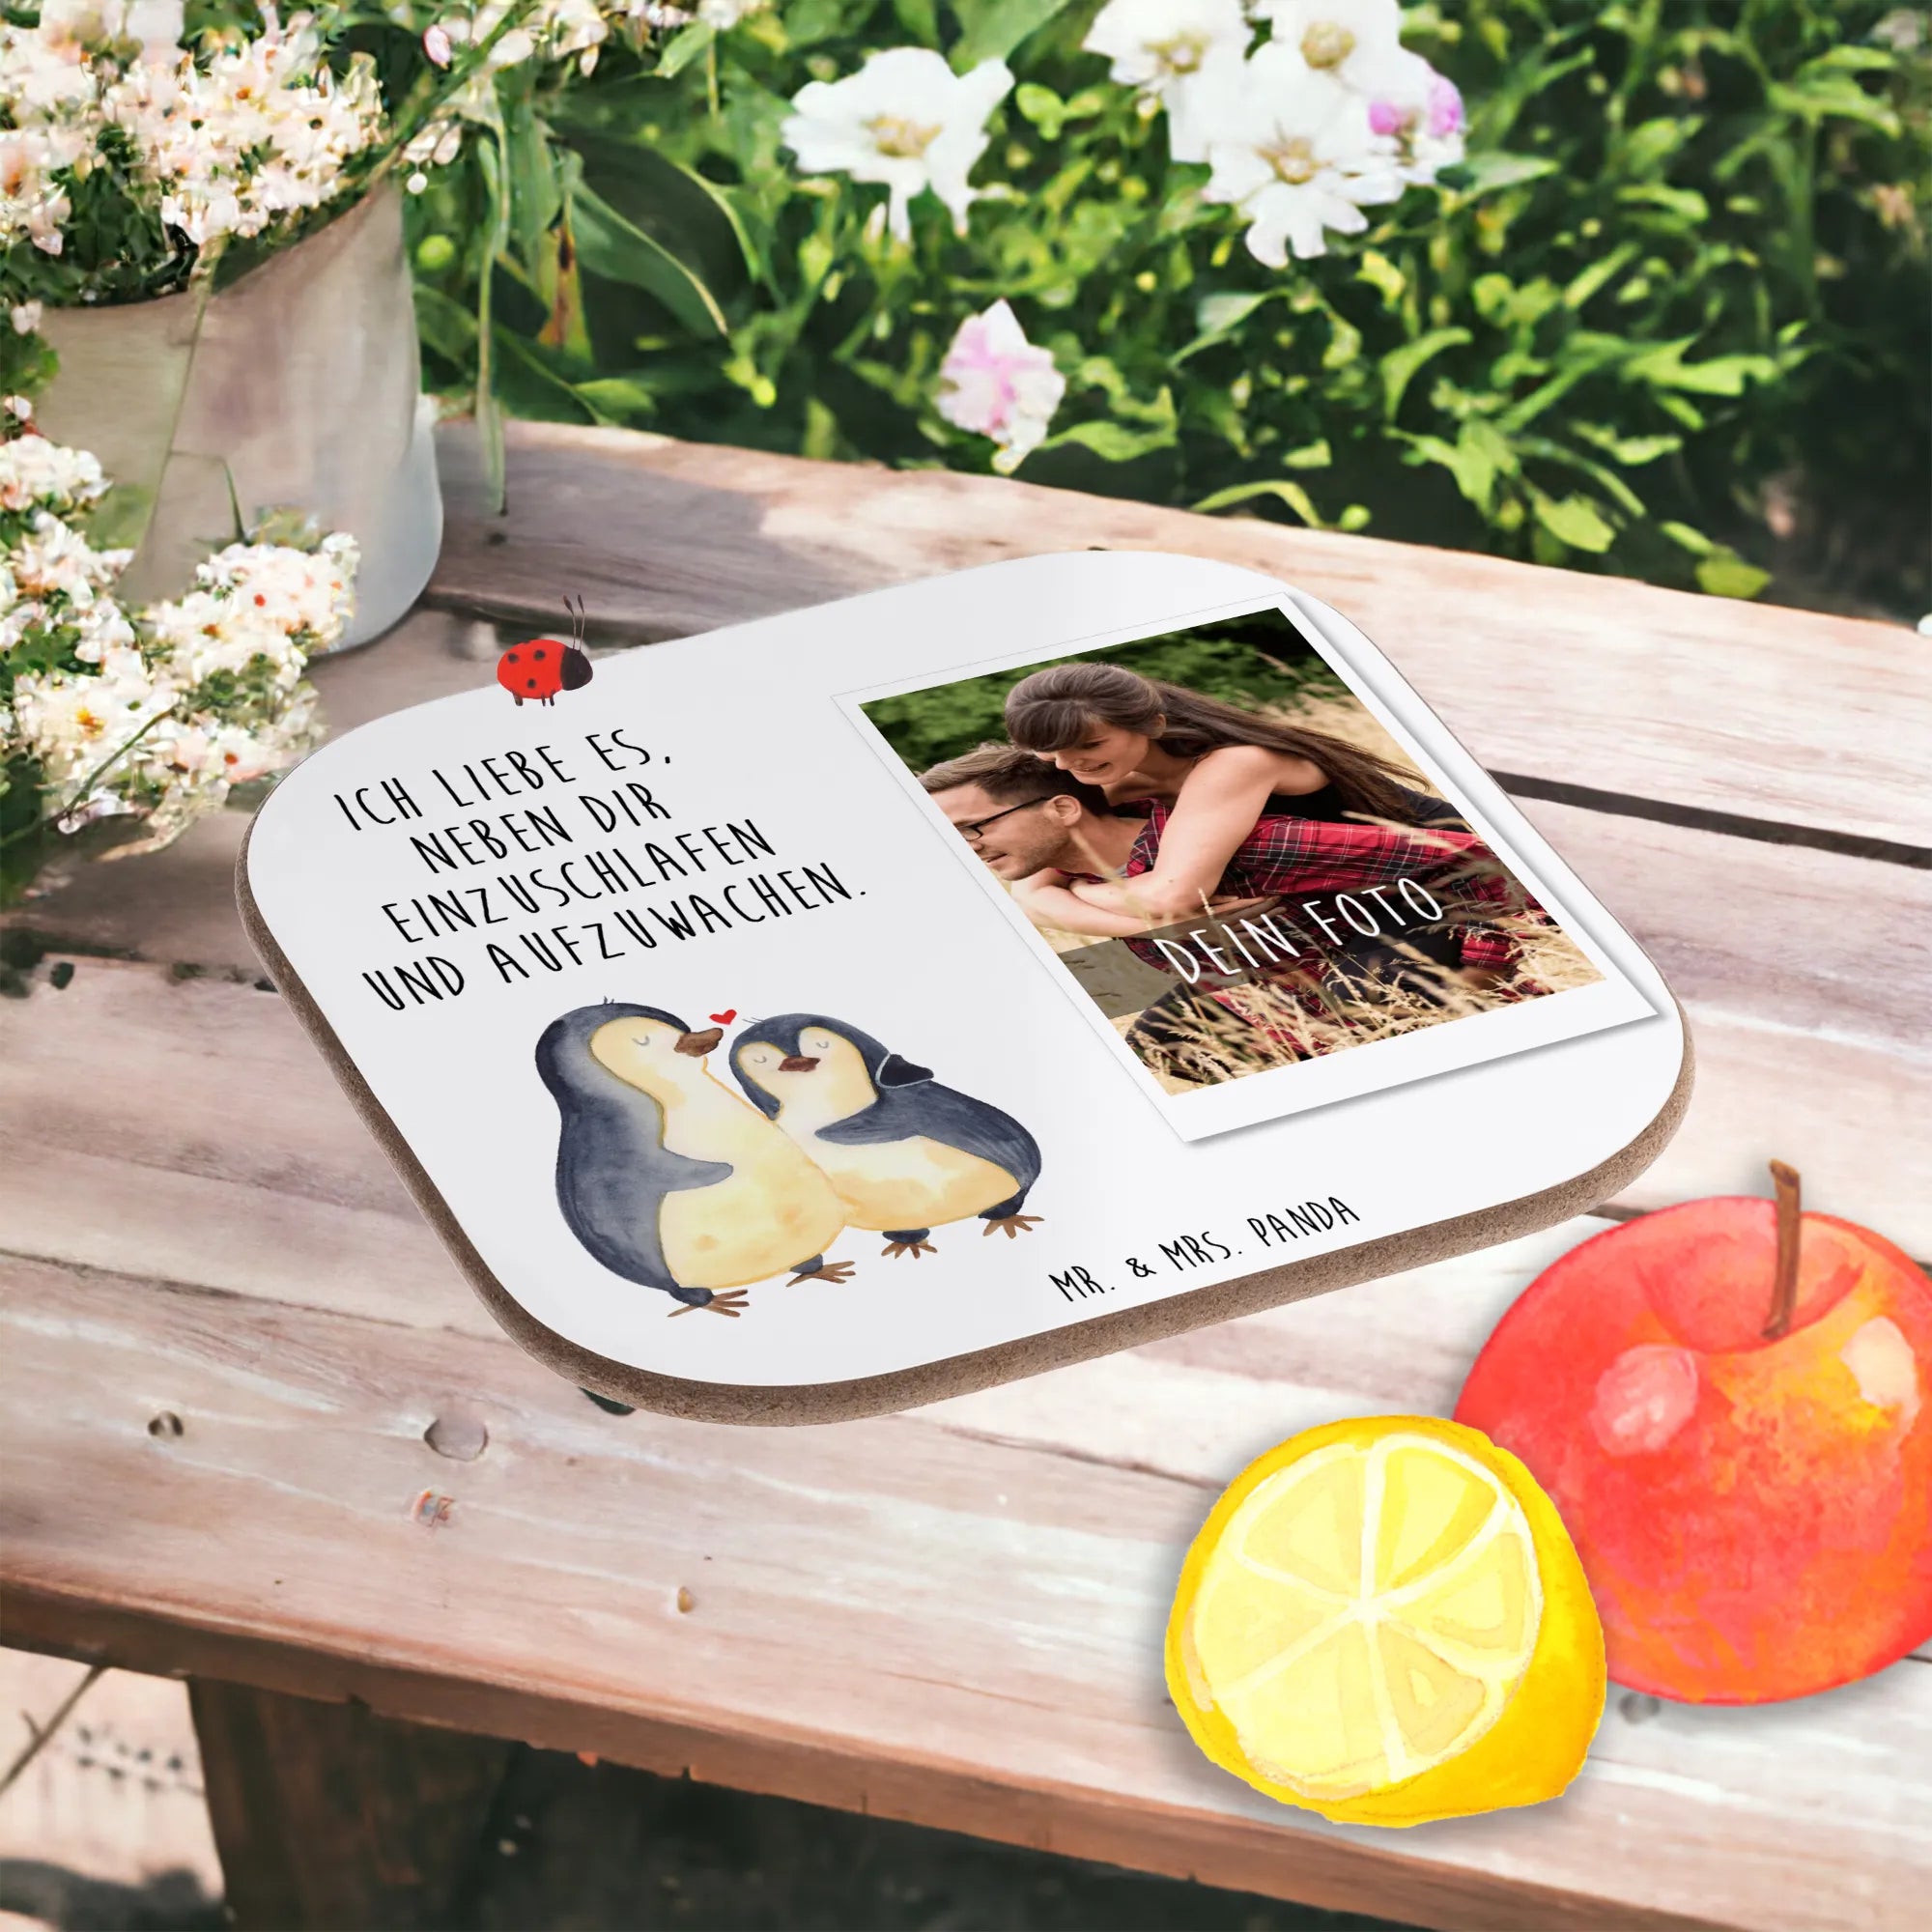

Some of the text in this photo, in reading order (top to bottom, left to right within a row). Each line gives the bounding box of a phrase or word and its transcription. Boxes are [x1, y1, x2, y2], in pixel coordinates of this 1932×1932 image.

[333, 777, 423, 832] ICH
[431, 745, 577, 808] LIEBE
[409, 782, 672, 874] NEBEN DIR
[381, 818, 777, 943] EINZUSCHLAFEN
[1152, 877, 1443, 984] DEIN FOTO
[361, 862, 867, 1011] UND AUFZUWACHEN.
[1047, 1196, 1361, 1302] MR. & MRS. PANDA
